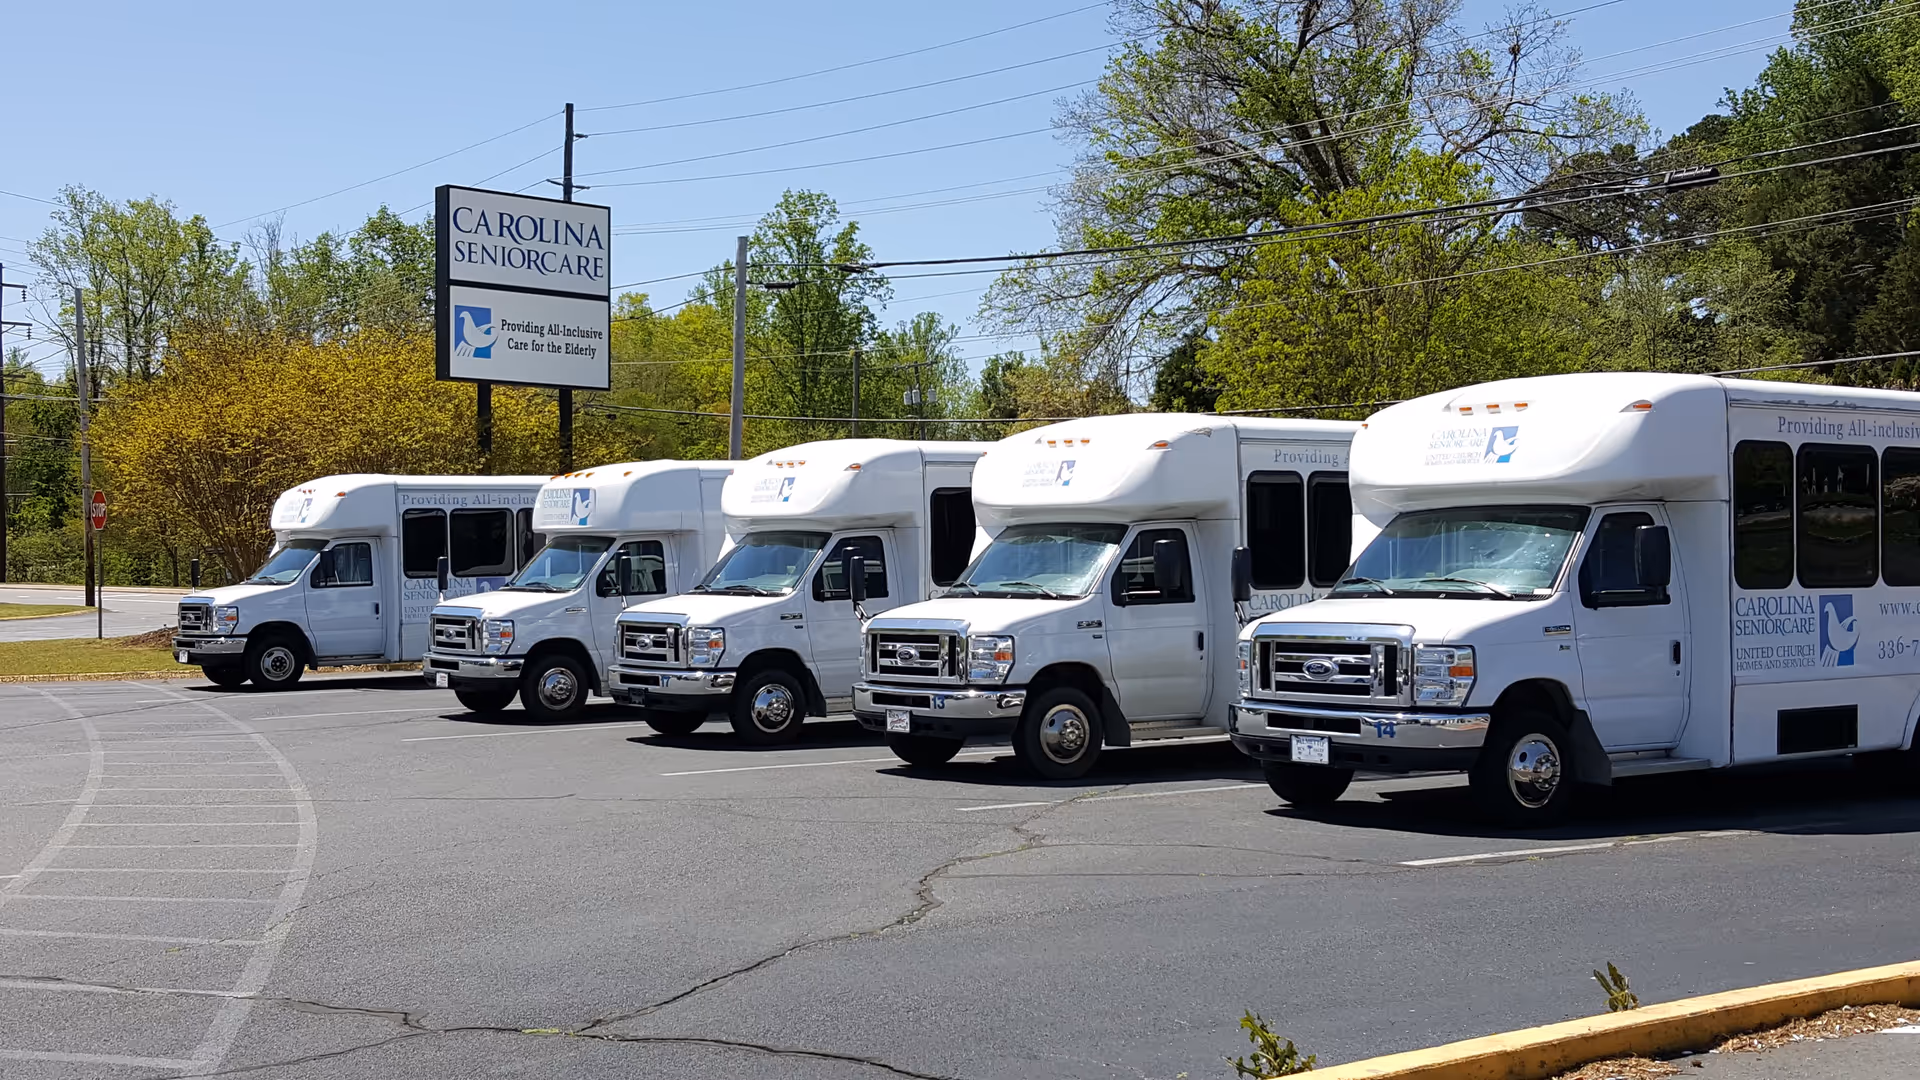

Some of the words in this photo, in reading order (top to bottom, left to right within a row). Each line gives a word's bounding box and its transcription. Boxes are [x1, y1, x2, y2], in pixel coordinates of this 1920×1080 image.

[452, 206, 605, 250] CAROLINA
[454, 240, 604, 281] SENIORCARE
[501, 319, 545, 338] Providing
[547, 323, 603, 340] All-Inclusive
[507, 338, 528, 351] Care
[531, 339, 544, 353] for
[547, 341, 562, 354] the
[565, 343, 597, 359] Elderly
[1777, 416, 1844, 440] Providing
[1273, 448, 1339, 468] Providing
[402, 494, 468, 507] Providing
[1735, 595, 1815, 619] CAROLINA
[1735, 617, 1815, 636] SENIORCARE
[1736, 646, 1774, 660] UNITED
[1776, 644, 1815, 657] CHURCH
[1879, 635, 1919, 660] 336-7
[1736, 660, 1763, 671] HOMES
[1764, 659, 1782, 669] AND
[1782, 658, 1816, 668] SERVICES
[932, 695, 946, 709] 13
[1374, 721, 1396, 739] 14
